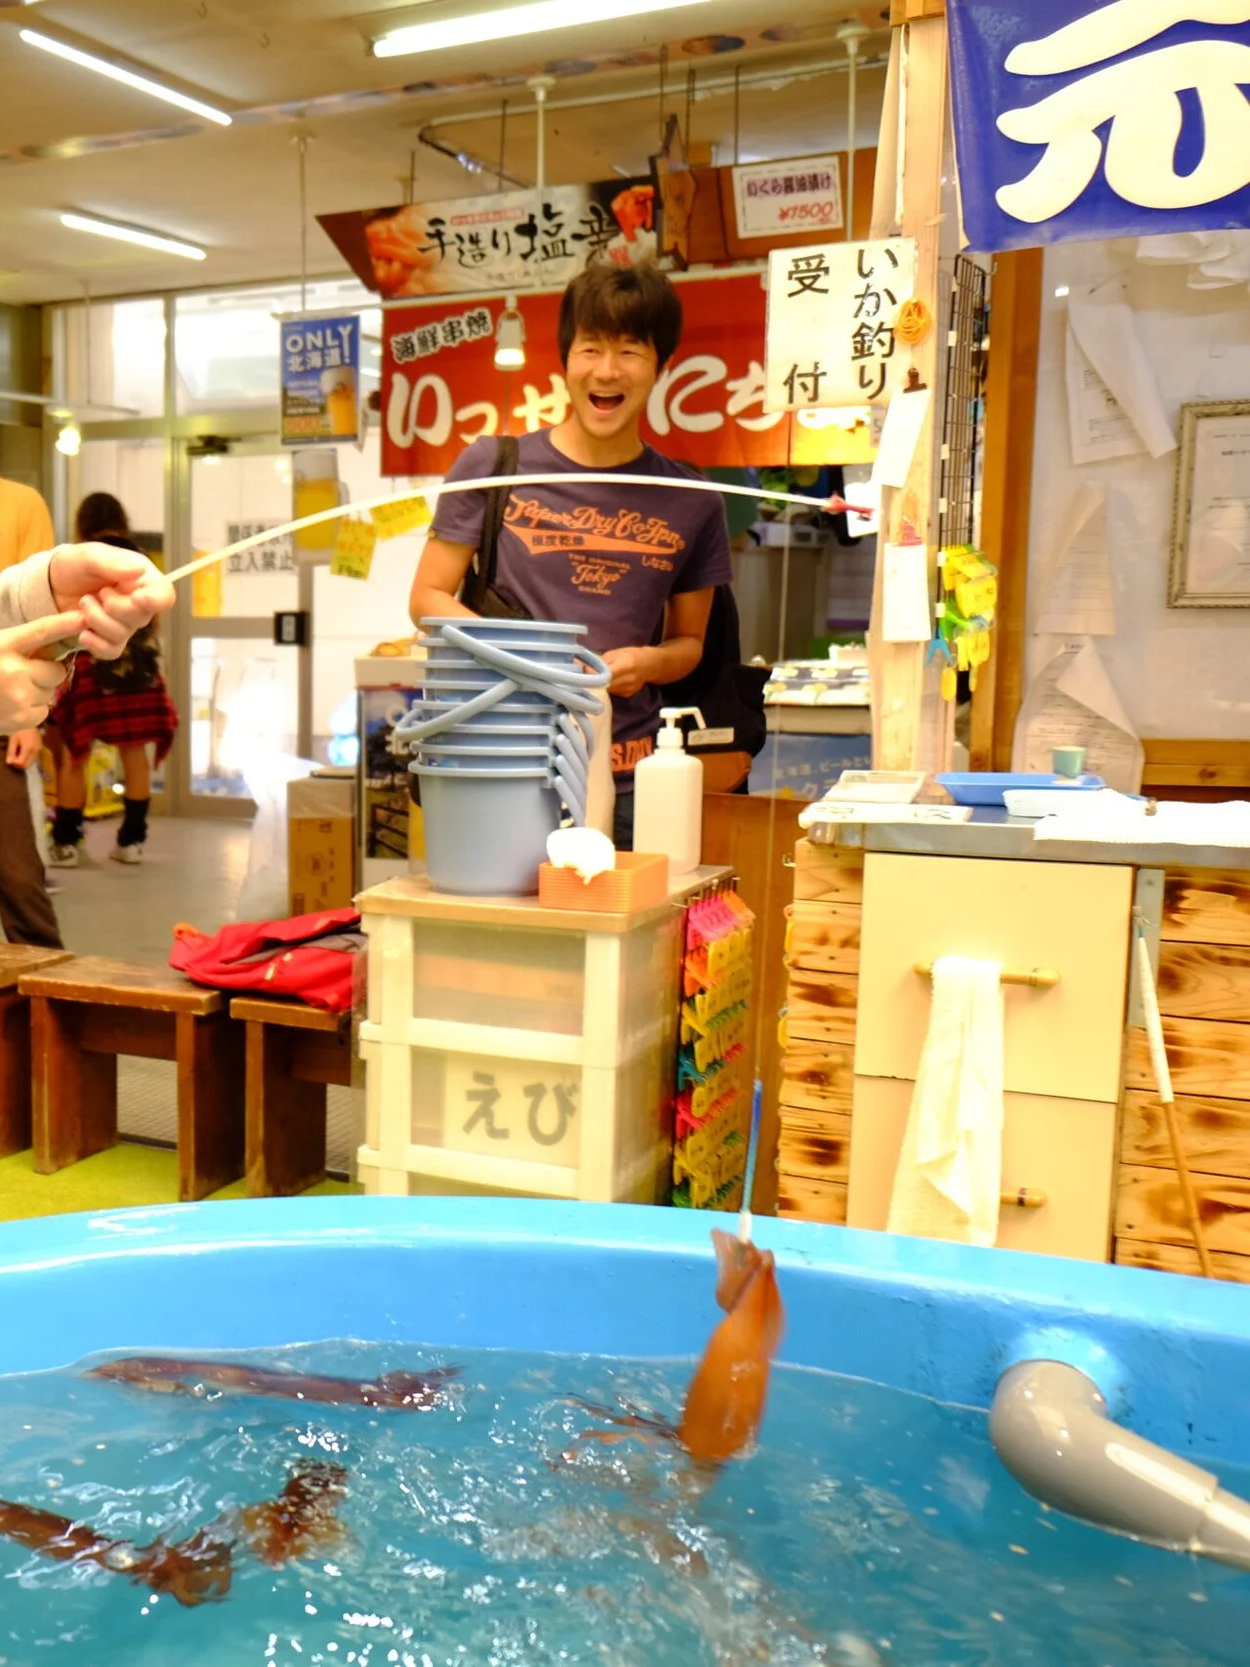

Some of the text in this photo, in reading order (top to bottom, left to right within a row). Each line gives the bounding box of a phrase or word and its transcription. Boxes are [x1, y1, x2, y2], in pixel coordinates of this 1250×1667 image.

[286, 324, 353, 354] ONLY
[390, 306, 493, 364] 海鮮串焼
[783, 253, 830, 404] 受付
[851, 248, 899, 401] いか釣り
[229, 550, 294, 573] 立入禁止
[462, 1071, 578, 1147] えび
